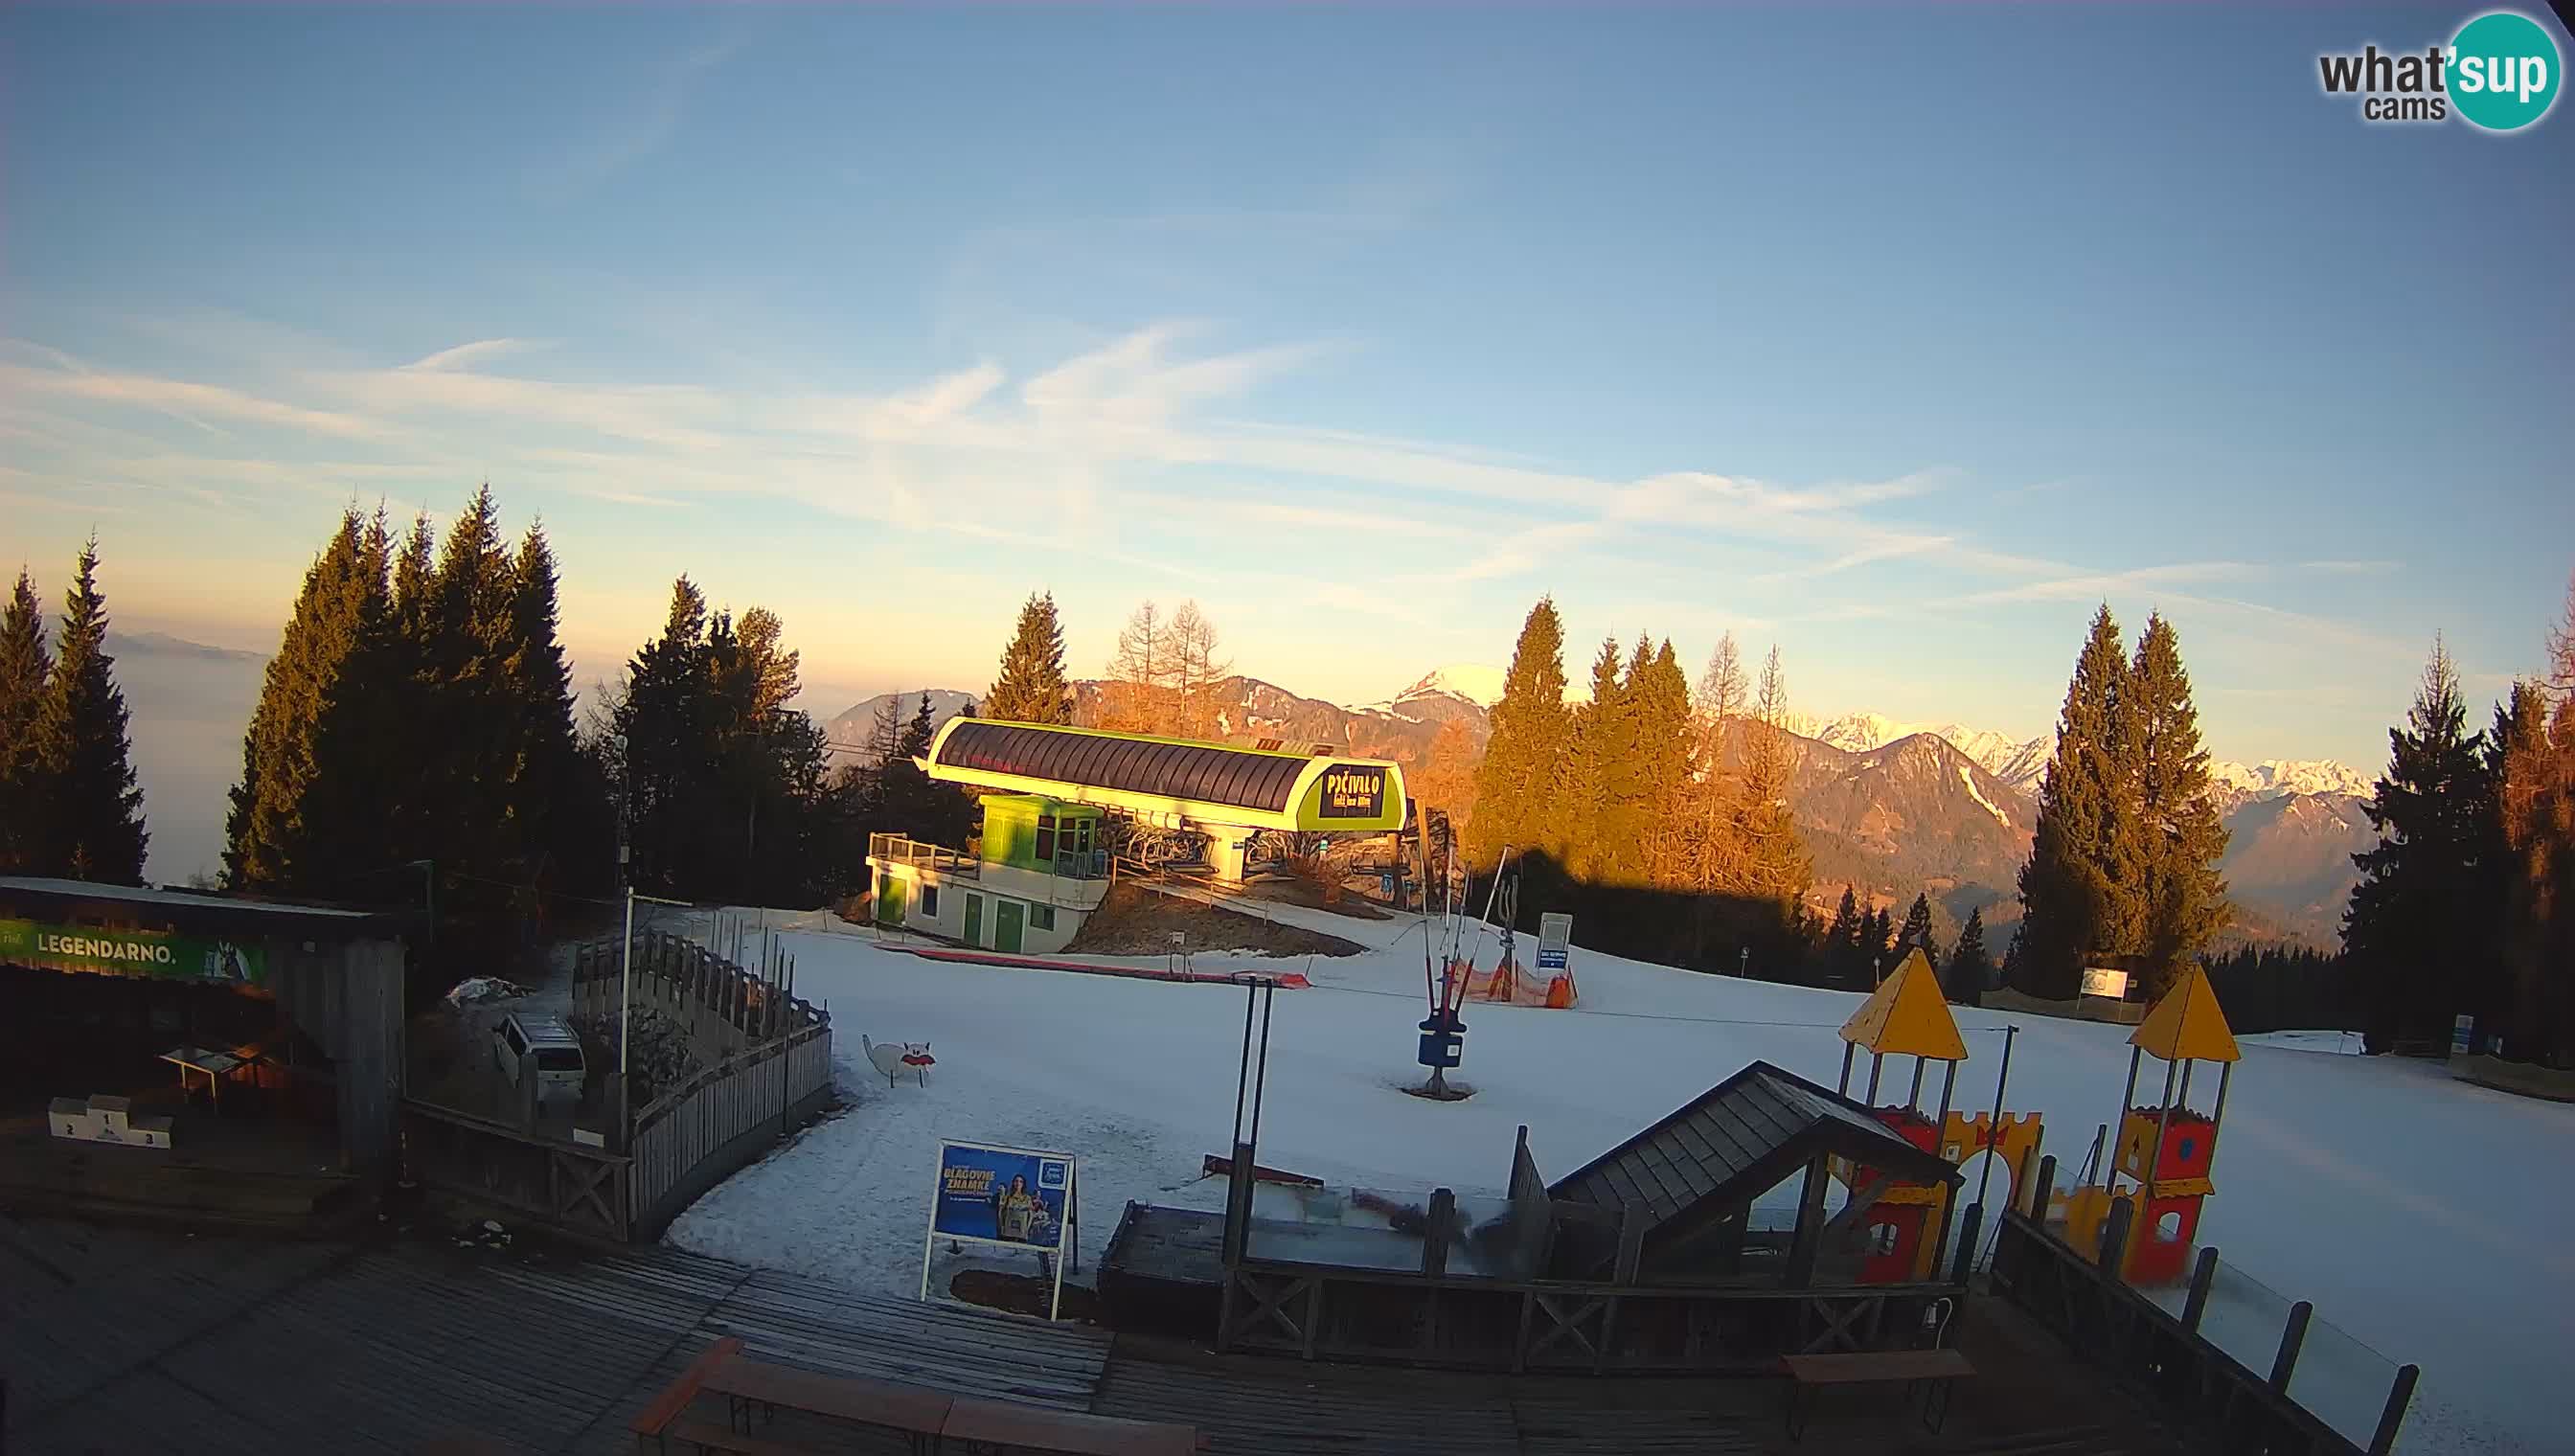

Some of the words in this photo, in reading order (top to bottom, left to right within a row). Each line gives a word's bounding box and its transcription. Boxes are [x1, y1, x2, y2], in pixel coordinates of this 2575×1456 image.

[38, 934, 176, 964] LEGENDARNO.
[67, 1124, 74, 1135] 2
[146, 1133, 154, 1145] 3
